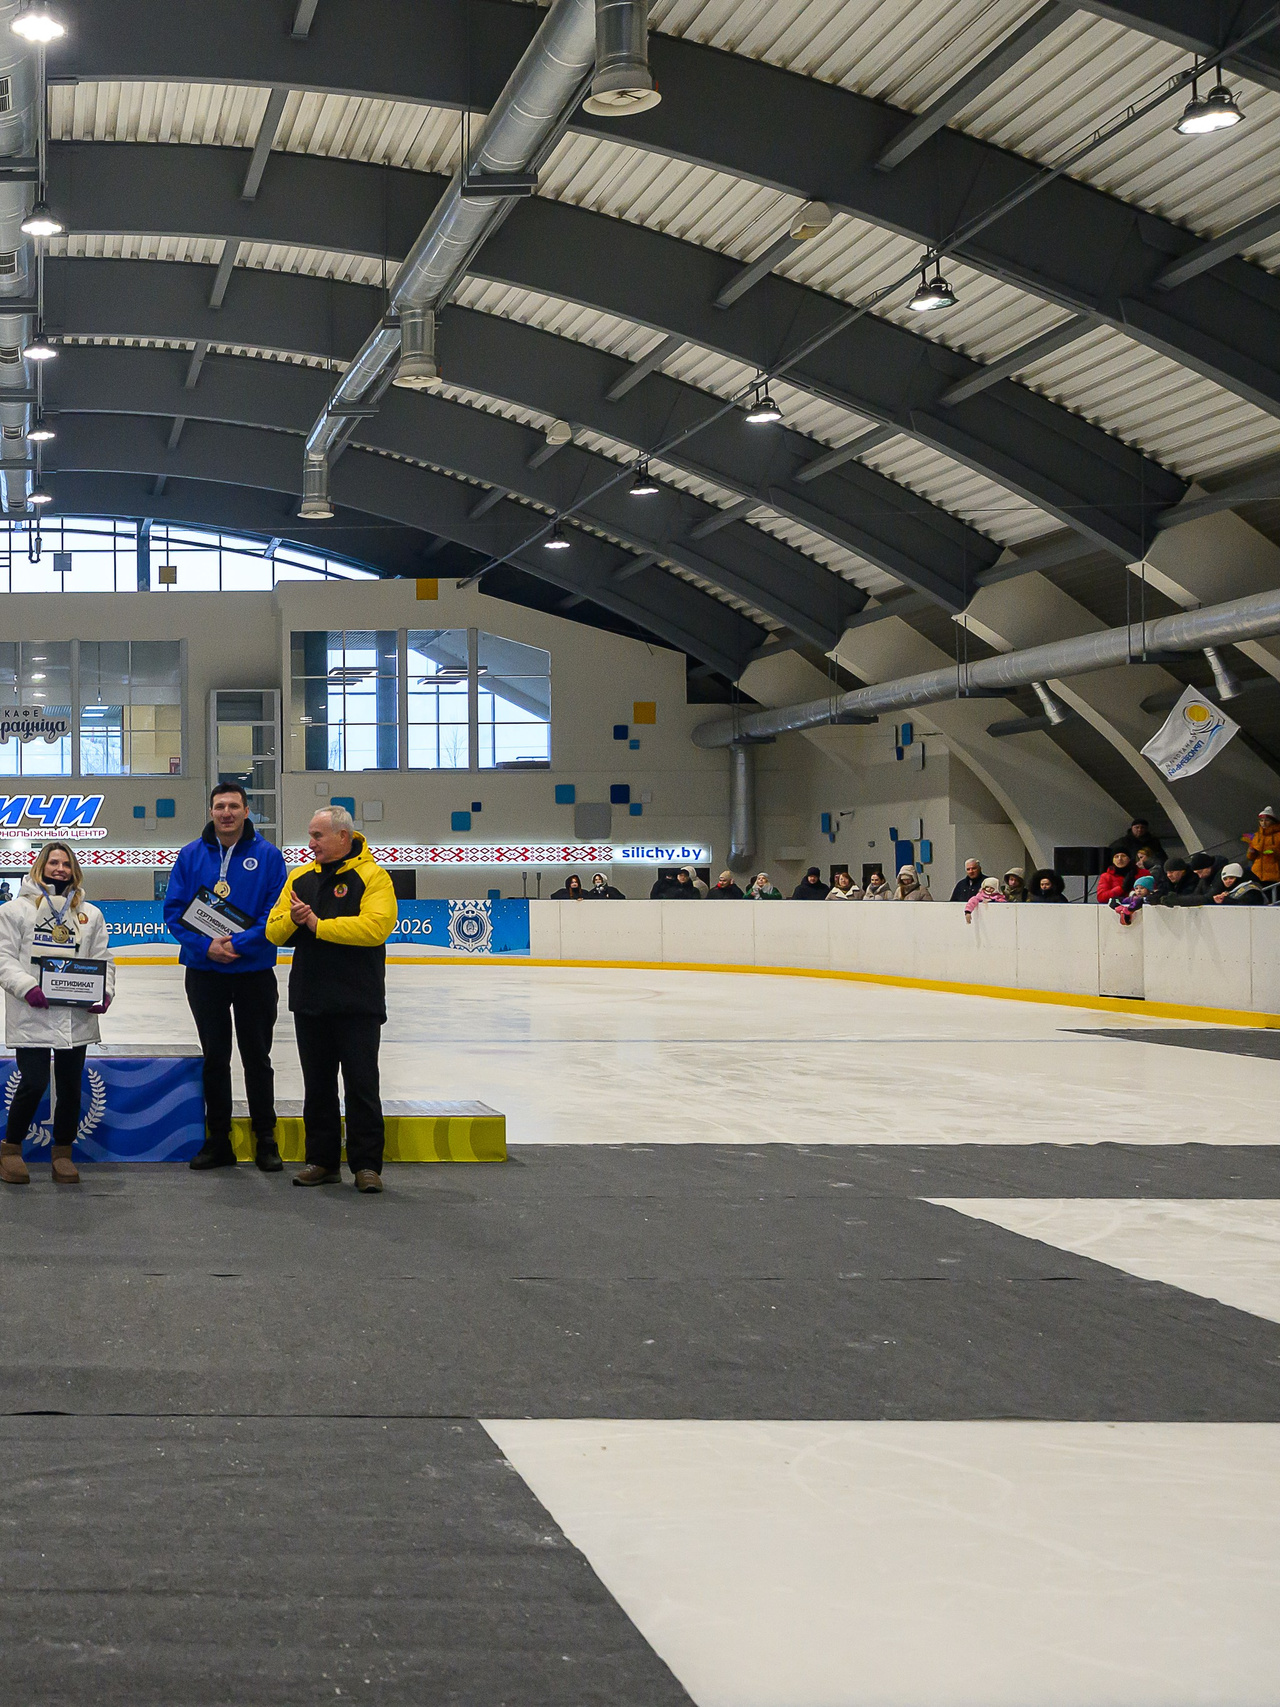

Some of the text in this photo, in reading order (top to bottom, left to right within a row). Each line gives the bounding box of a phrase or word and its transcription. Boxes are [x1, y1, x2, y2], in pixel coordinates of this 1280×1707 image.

[4, 709, 39, 718] КАФЕ
[71, 829, 105, 840] ЦЕНТР
[622, 847, 702, 860] silichy.by
[391, 919, 433, 935] 2026
[50, 979, 95, 989] СЕРТИФИКАТ
